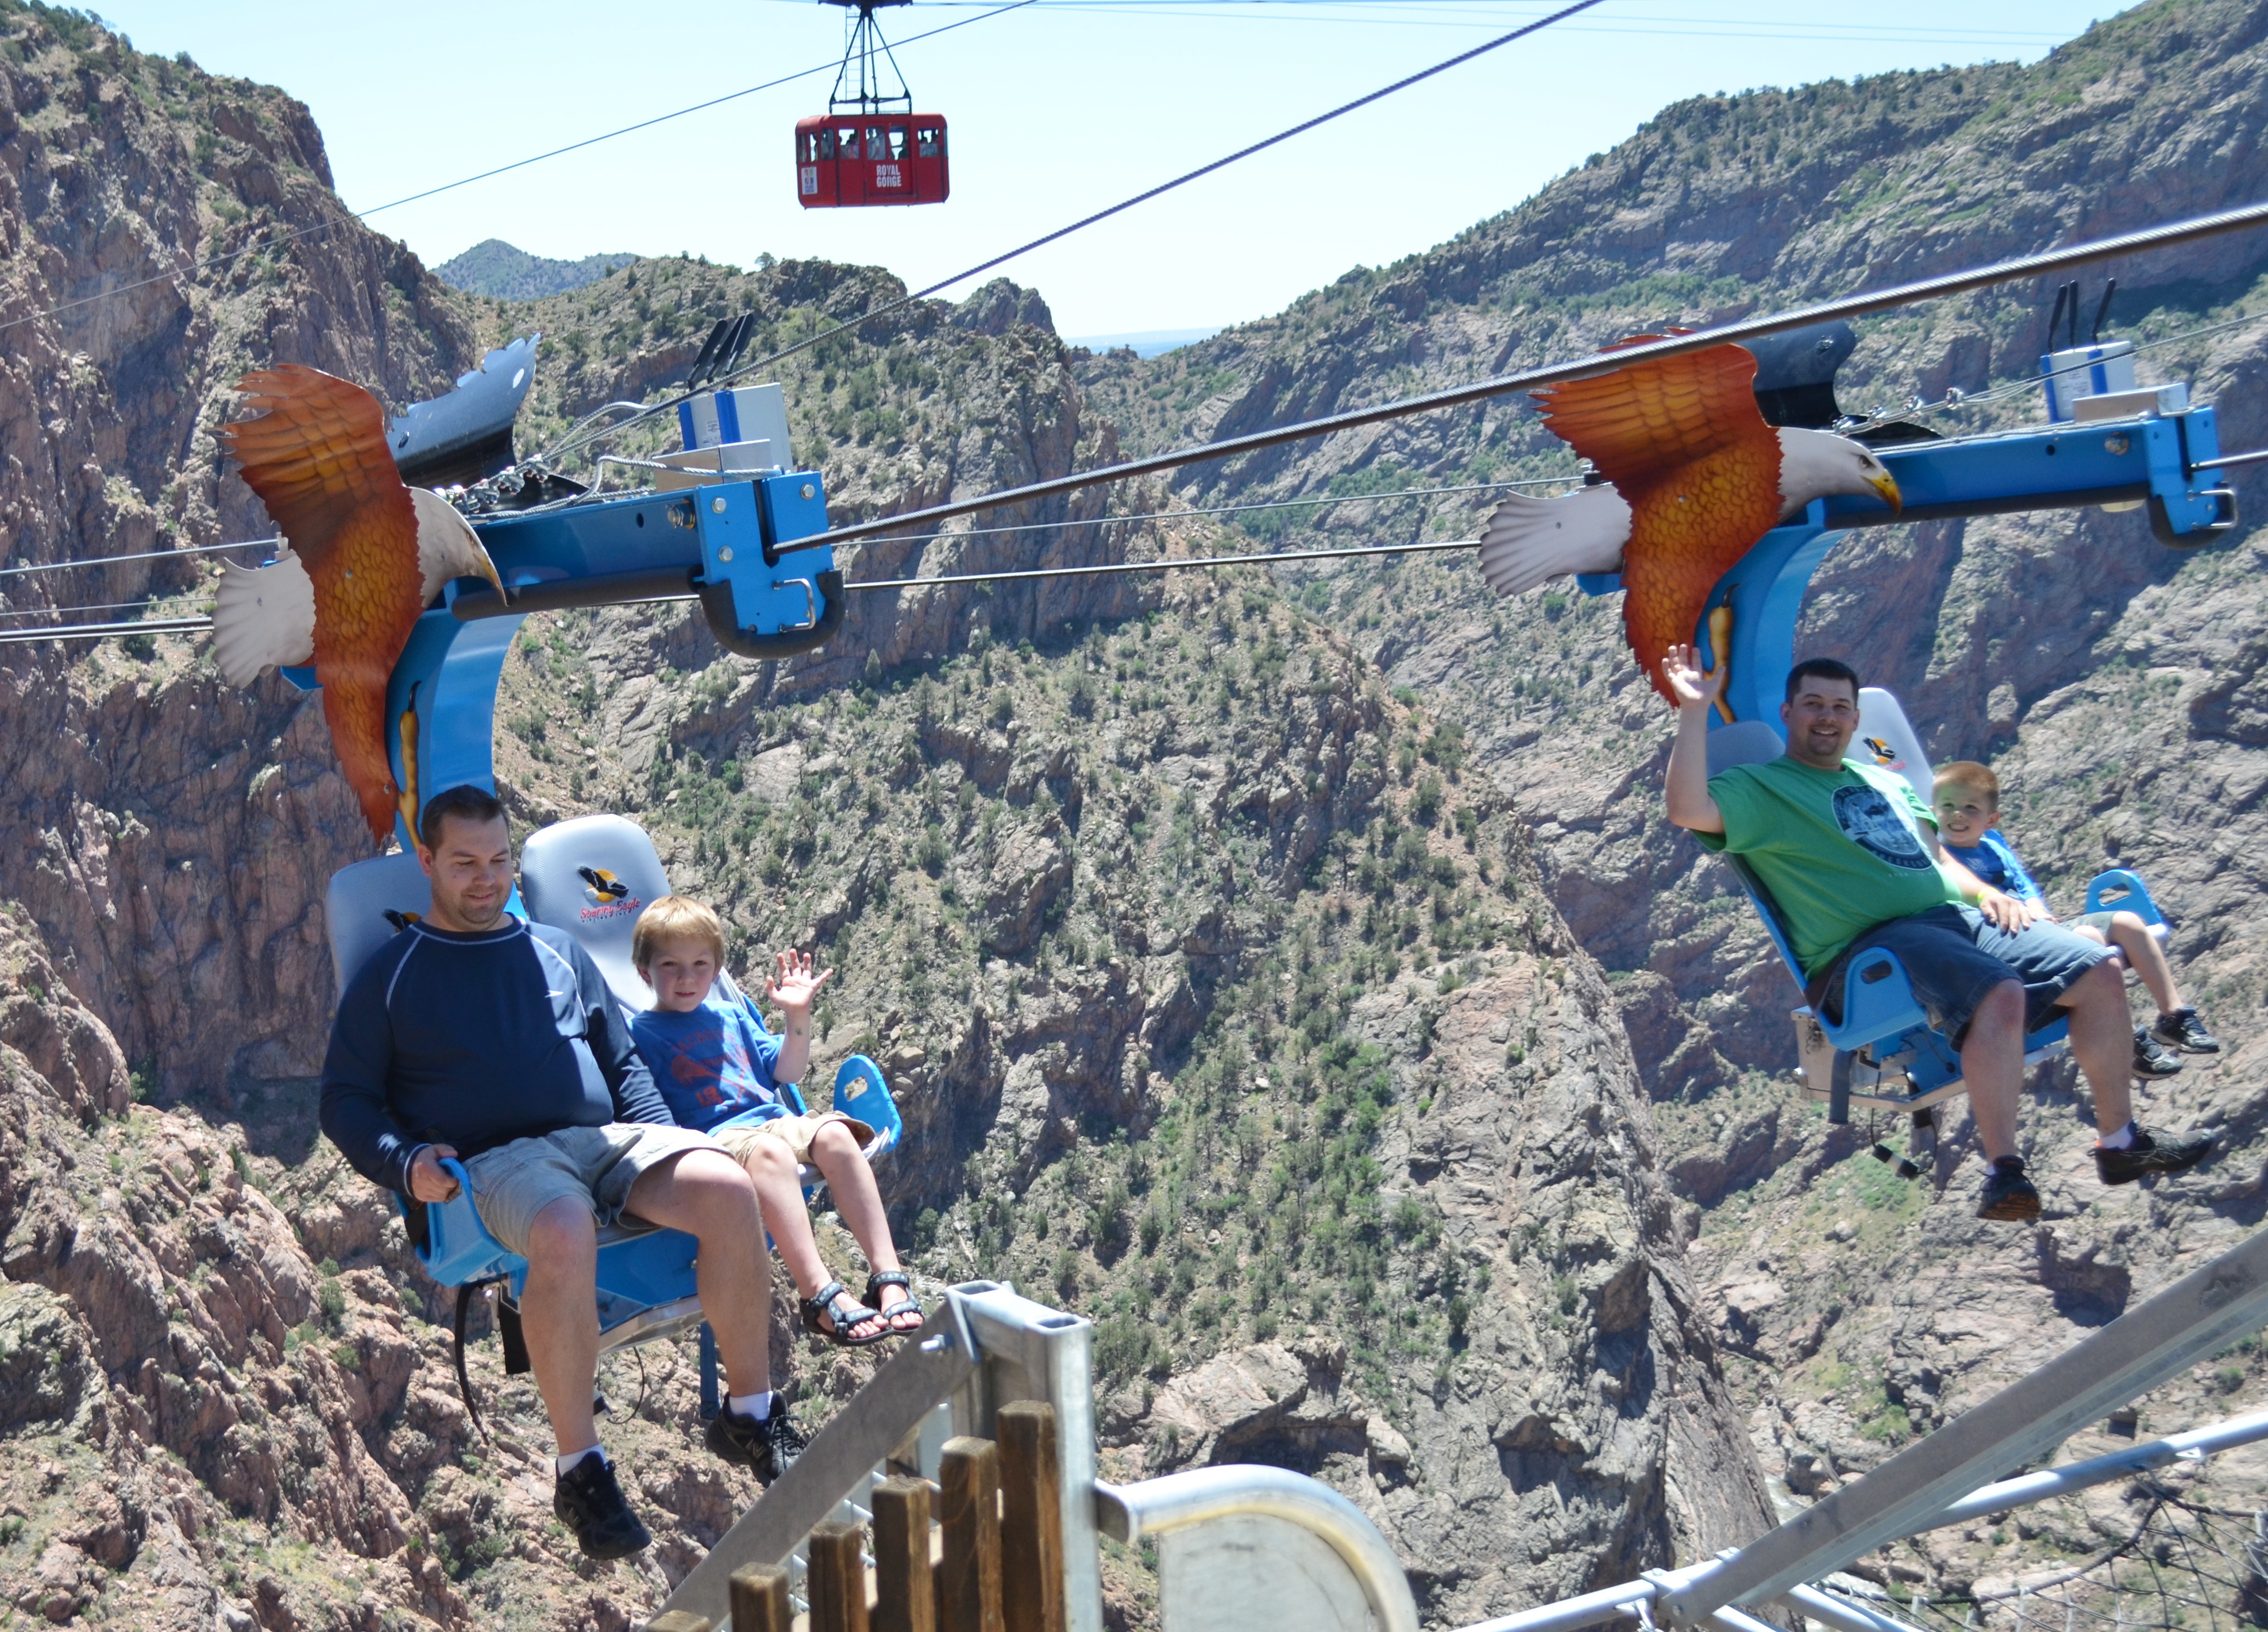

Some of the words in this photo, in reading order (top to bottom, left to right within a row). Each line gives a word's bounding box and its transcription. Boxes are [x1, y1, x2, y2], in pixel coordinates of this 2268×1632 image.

[876, 164, 901, 176] ROYAL
[876, 176, 902, 187] GORGE
[580, 905, 614, 919] Soaring
[616, 897, 641, 913] Eagle
